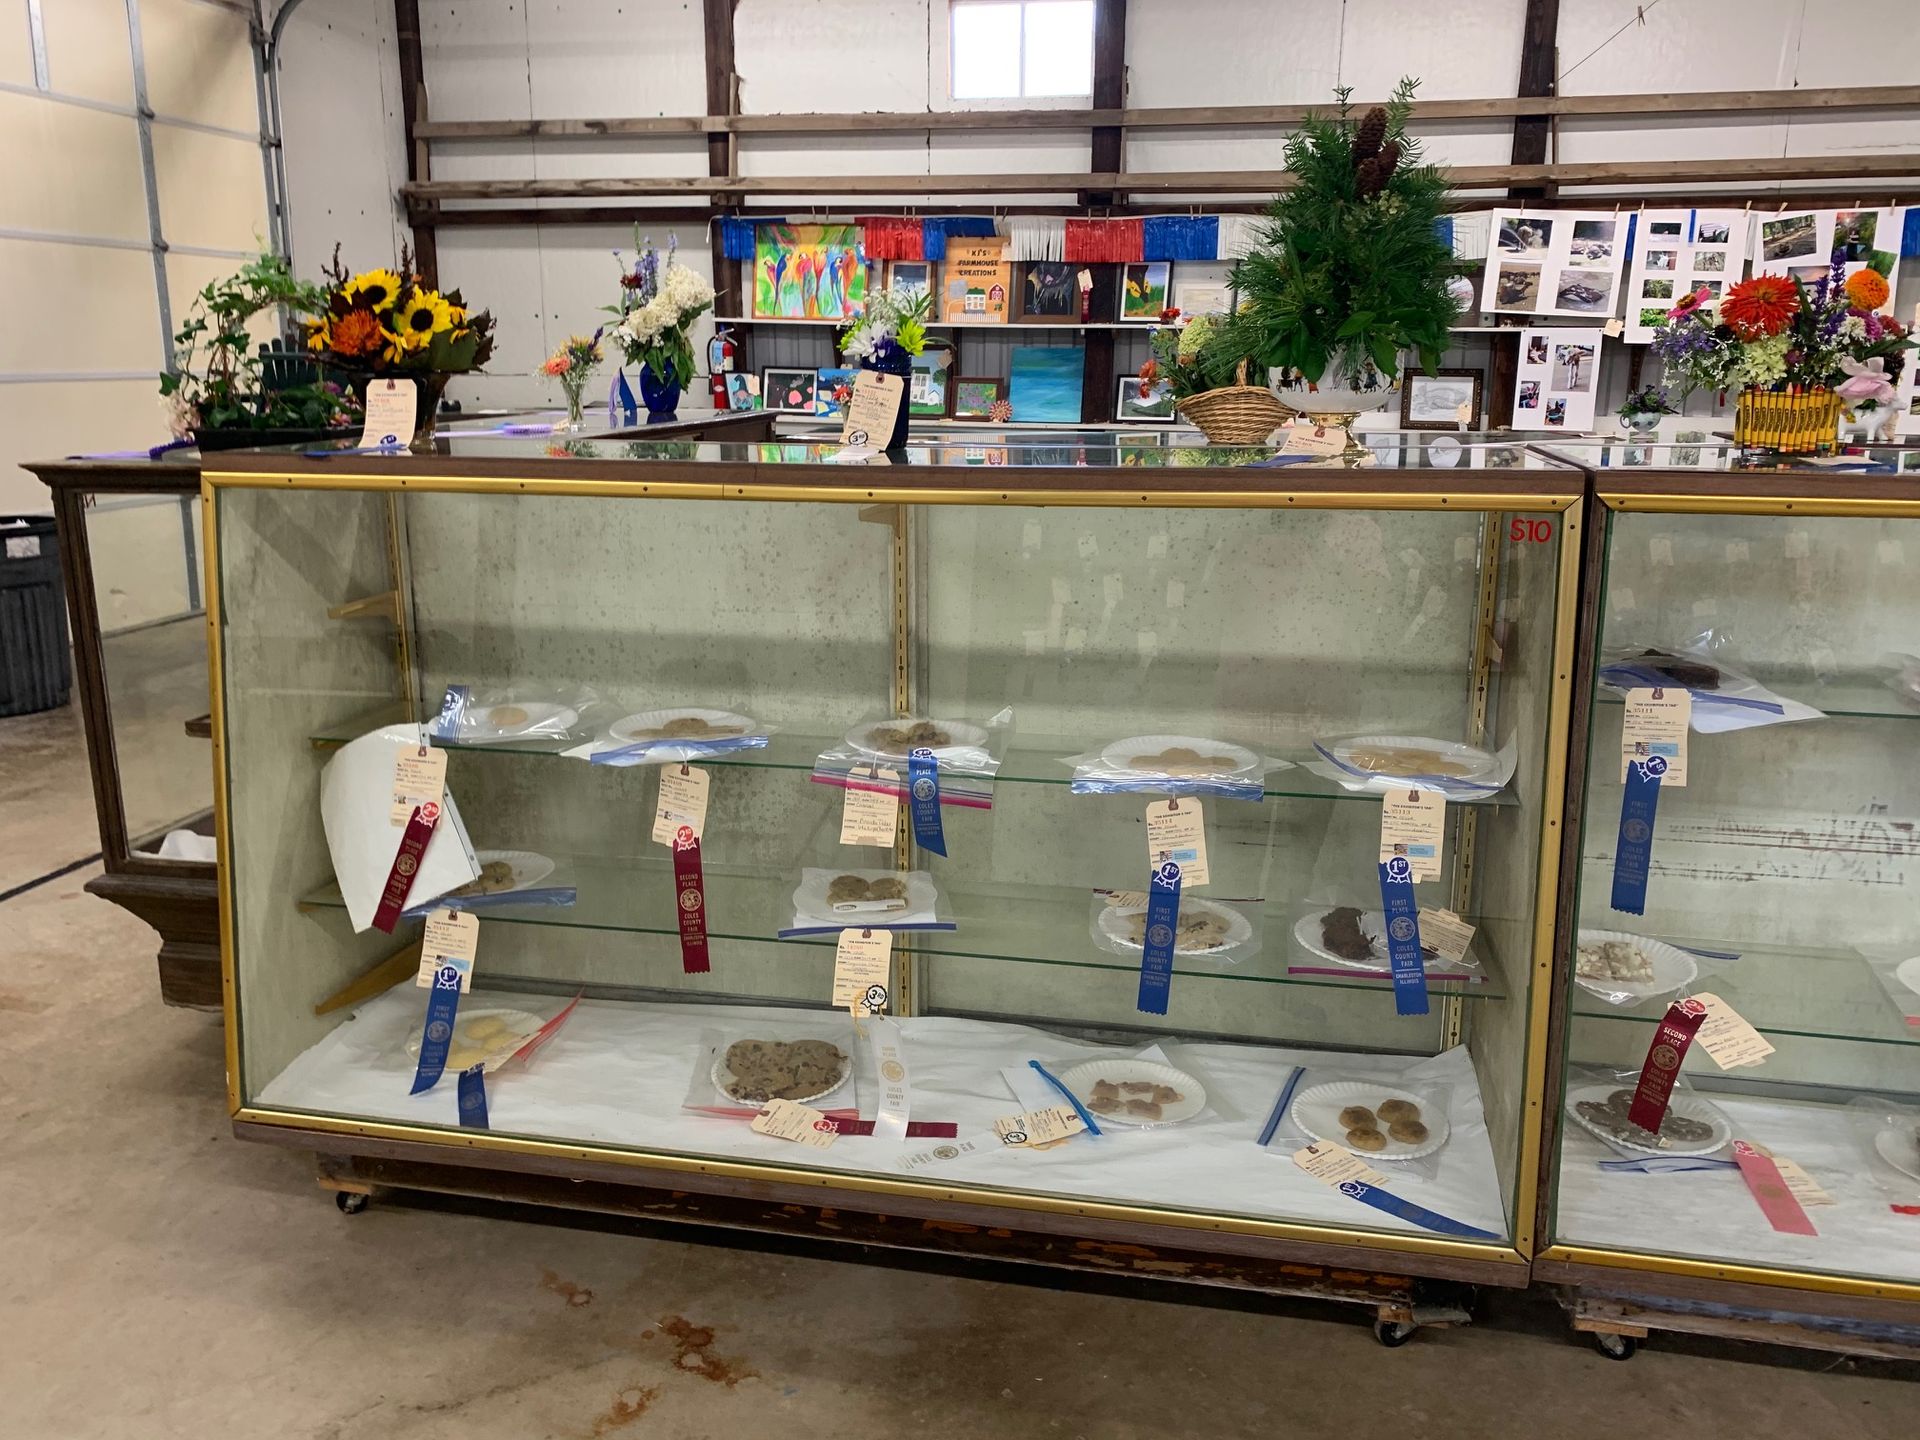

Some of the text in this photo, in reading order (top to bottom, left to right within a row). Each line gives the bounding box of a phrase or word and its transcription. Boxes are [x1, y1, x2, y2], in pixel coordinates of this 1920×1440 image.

[1510, 519, 1552, 543] S10
[1647, 758, 1666, 772] 1ST
[1162, 865, 1178, 877] 1ST
[1391, 860, 1407, 873] 1ST
[1391, 906, 1408, 914] PLACE
[1155, 914, 1171, 922] PLACE
[1151, 950, 1167, 958] COLES
[1395, 952, 1417, 960] COUNTY
[1147, 956, 1168, 964] COUNTY
[442, 969, 456, 980] 1ST
[869, 989, 885, 1000] 3RD
